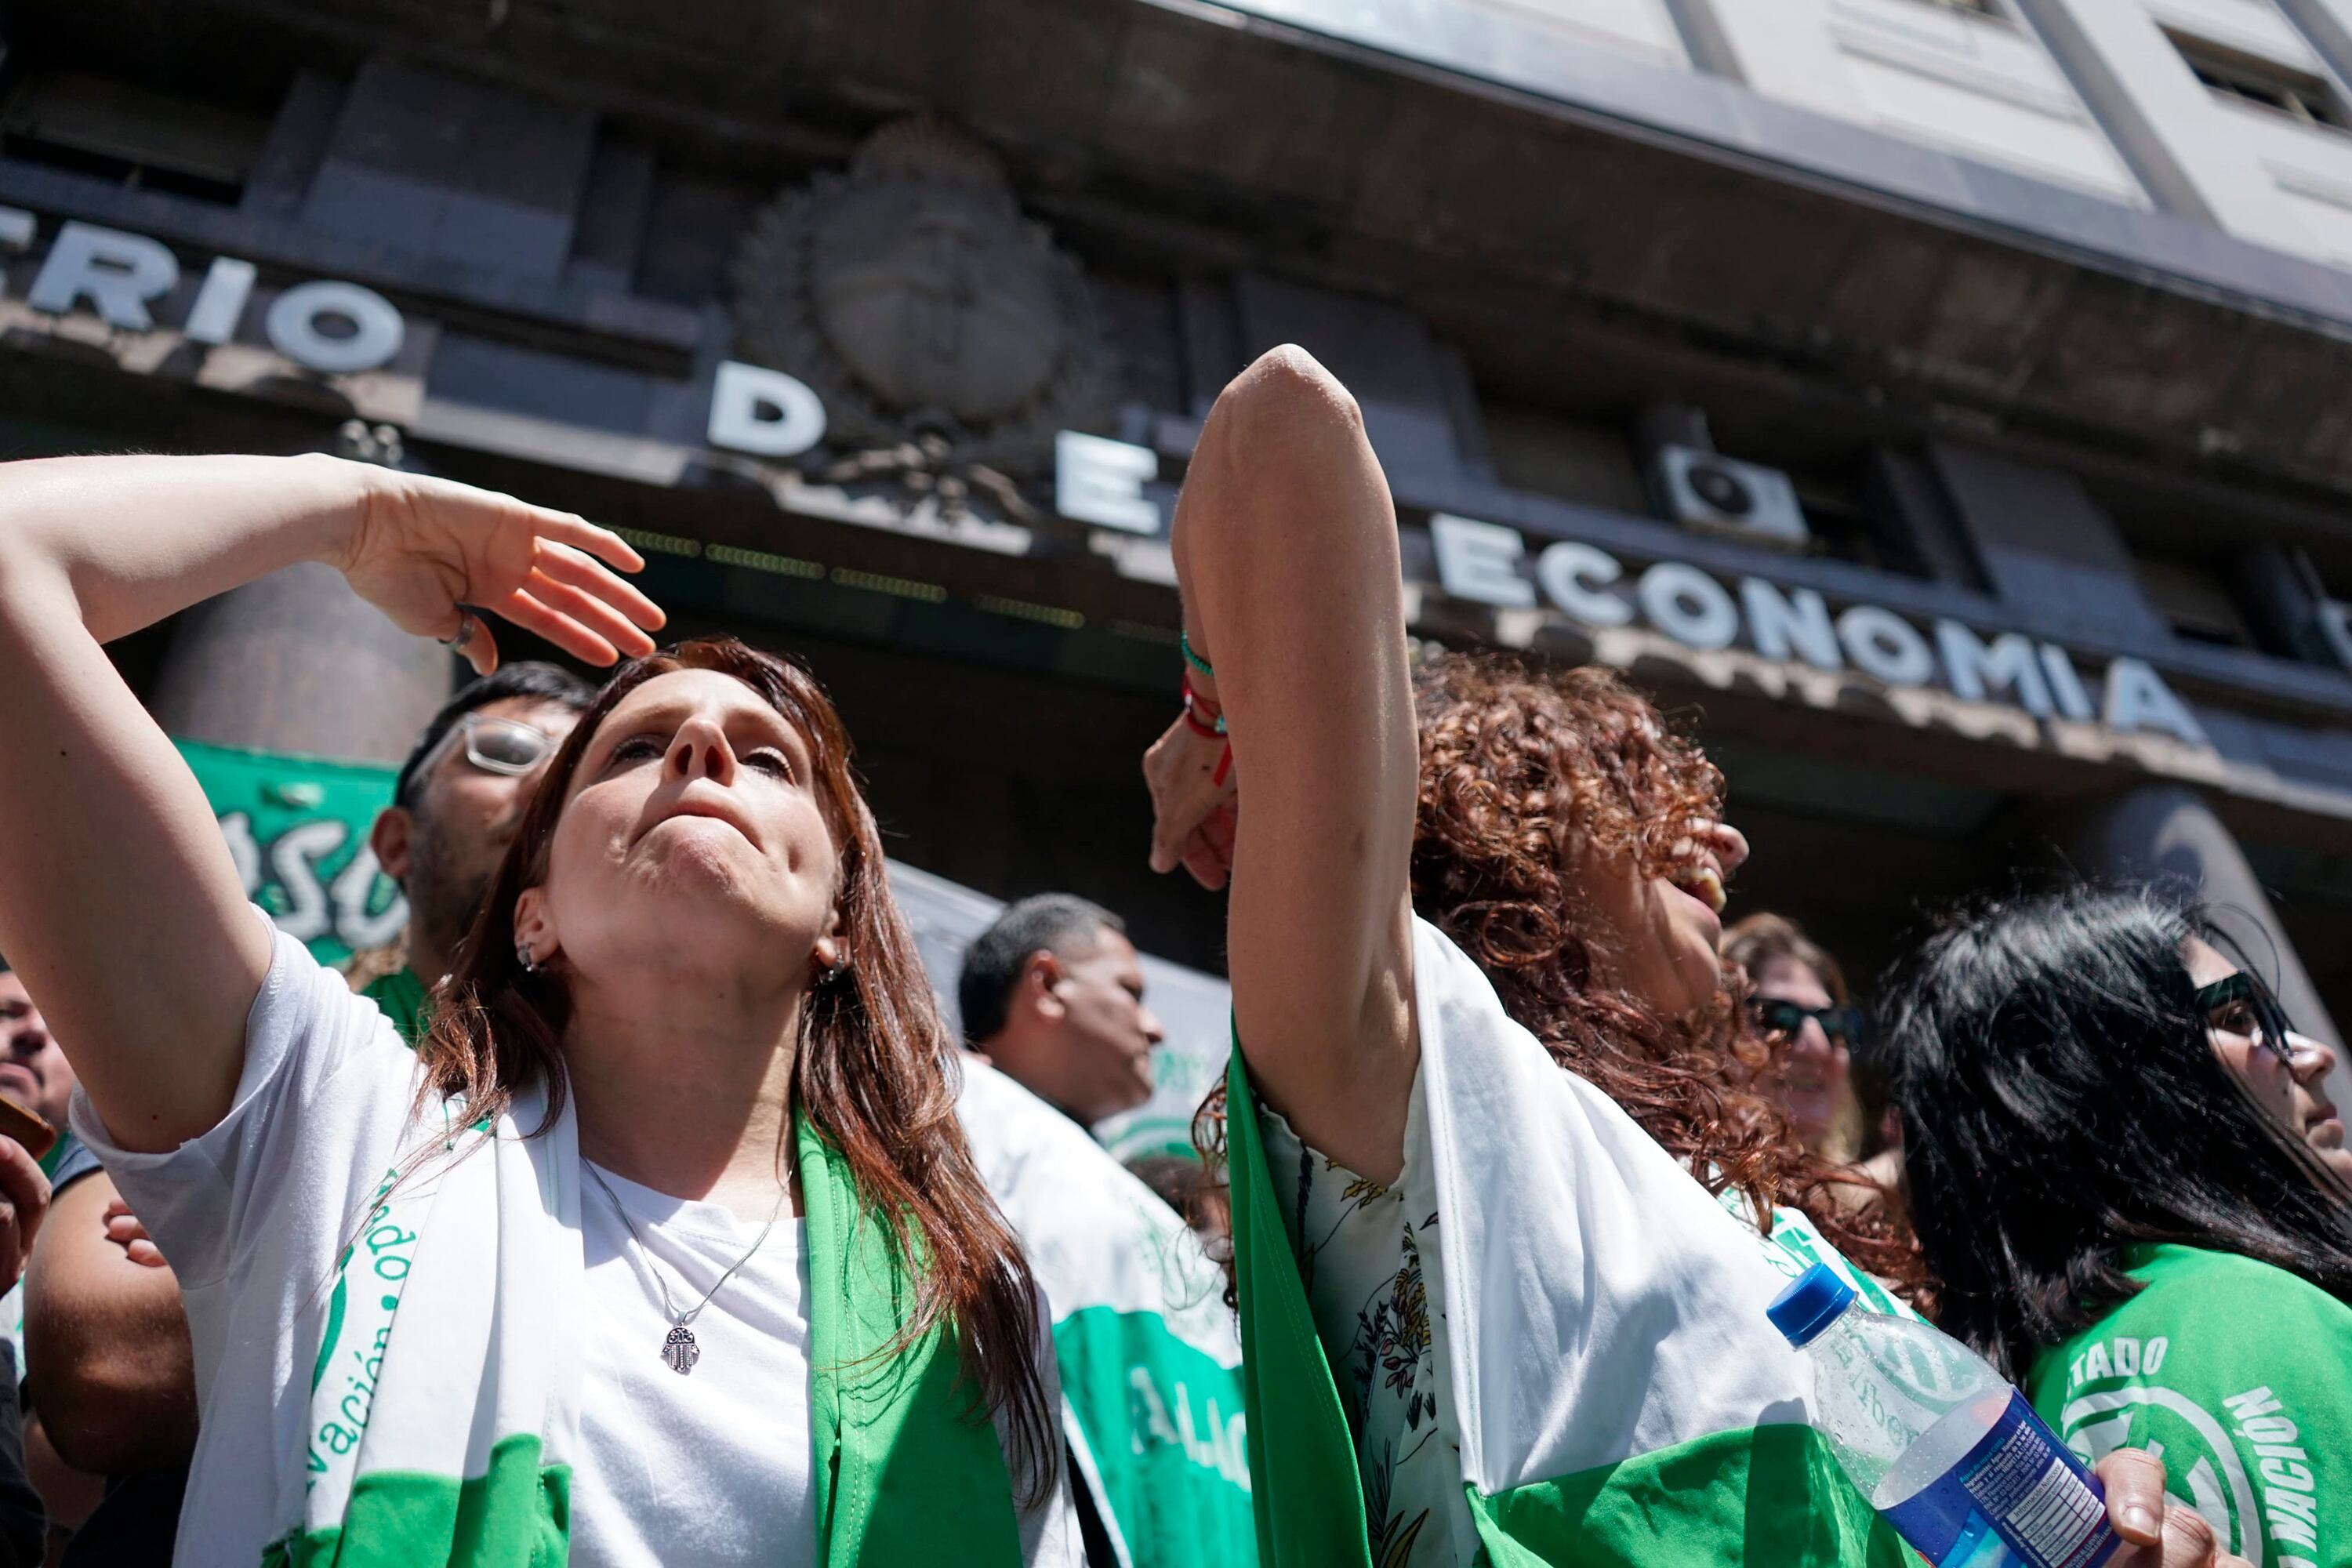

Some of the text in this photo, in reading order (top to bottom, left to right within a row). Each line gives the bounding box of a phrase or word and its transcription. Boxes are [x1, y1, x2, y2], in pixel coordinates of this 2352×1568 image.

[1429, 511, 2208, 745] ECONOMIA
[307, 1327, 391, 1478] vación
[2065, 1336, 2168, 1399] TADO
[2013, 1486, 2045, 1519] Información
[2222, 1386, 2317, 1552] NACIÓN
